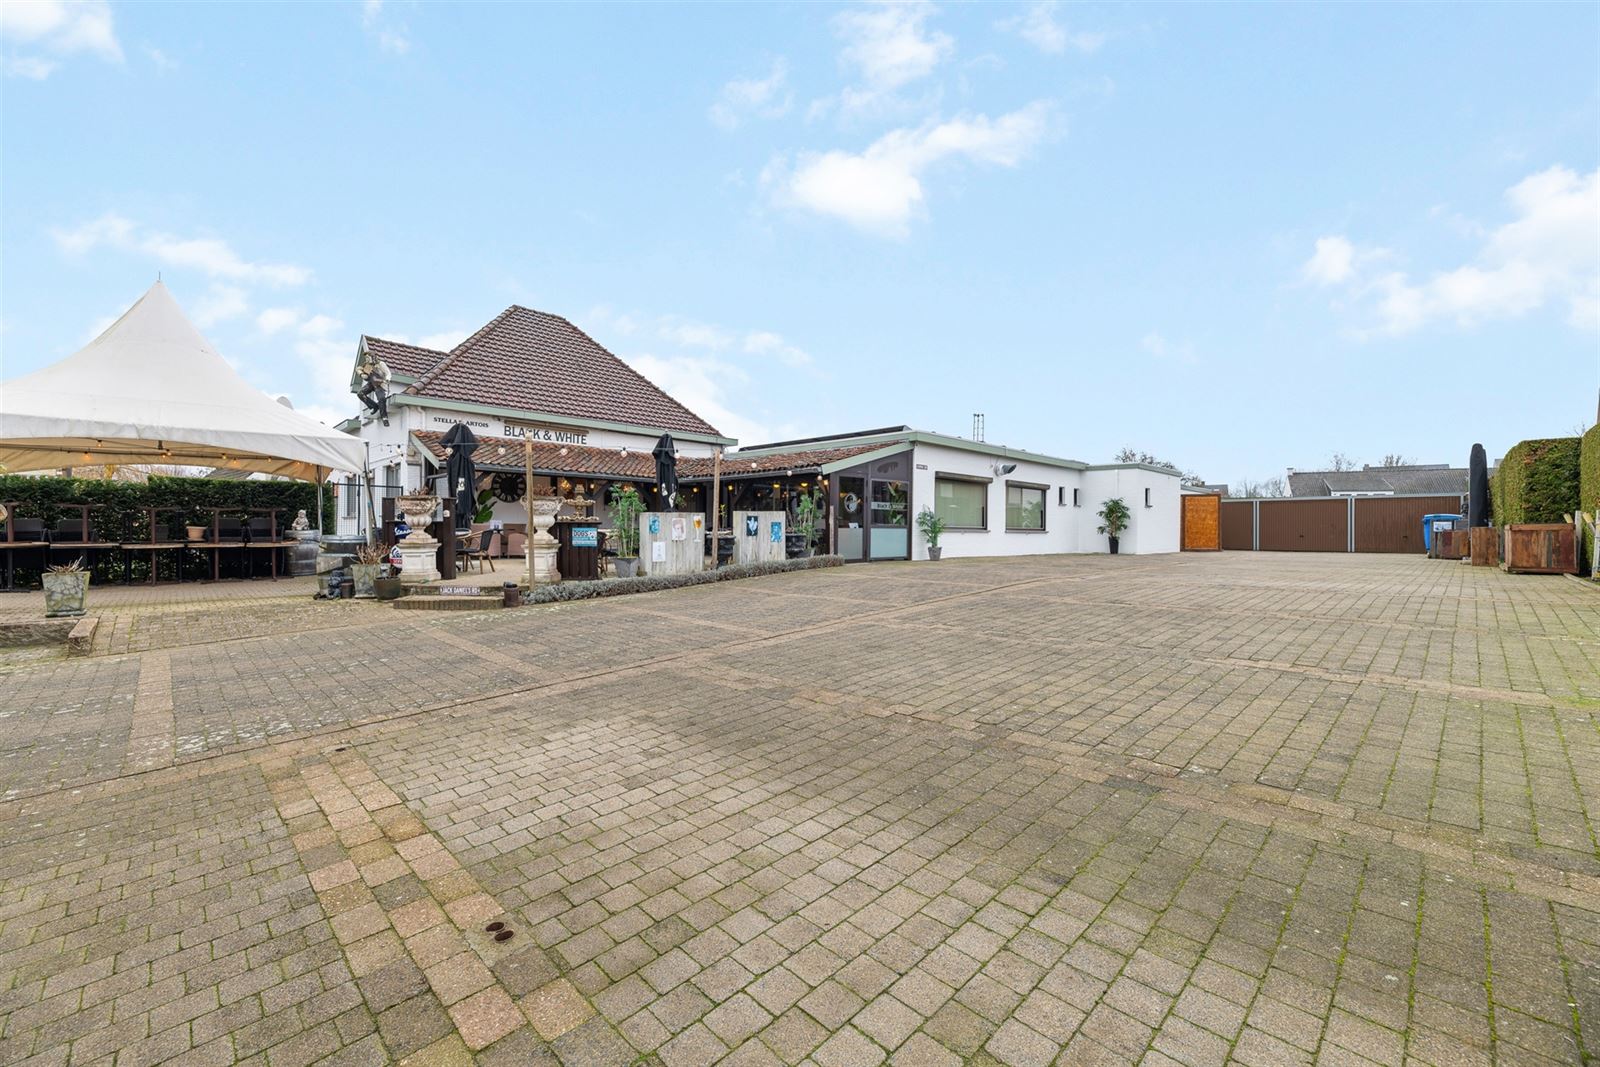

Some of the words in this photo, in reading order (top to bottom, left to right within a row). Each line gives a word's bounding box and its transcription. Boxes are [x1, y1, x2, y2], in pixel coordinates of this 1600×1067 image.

[433, 416, 458, 425] STELLA
[465, 420, 489, 428] ARTOIS
[504, 425, 540, 440] BLAK
[543, 430, 552, 441] &
[554, 431, 587, 445] WHITE
